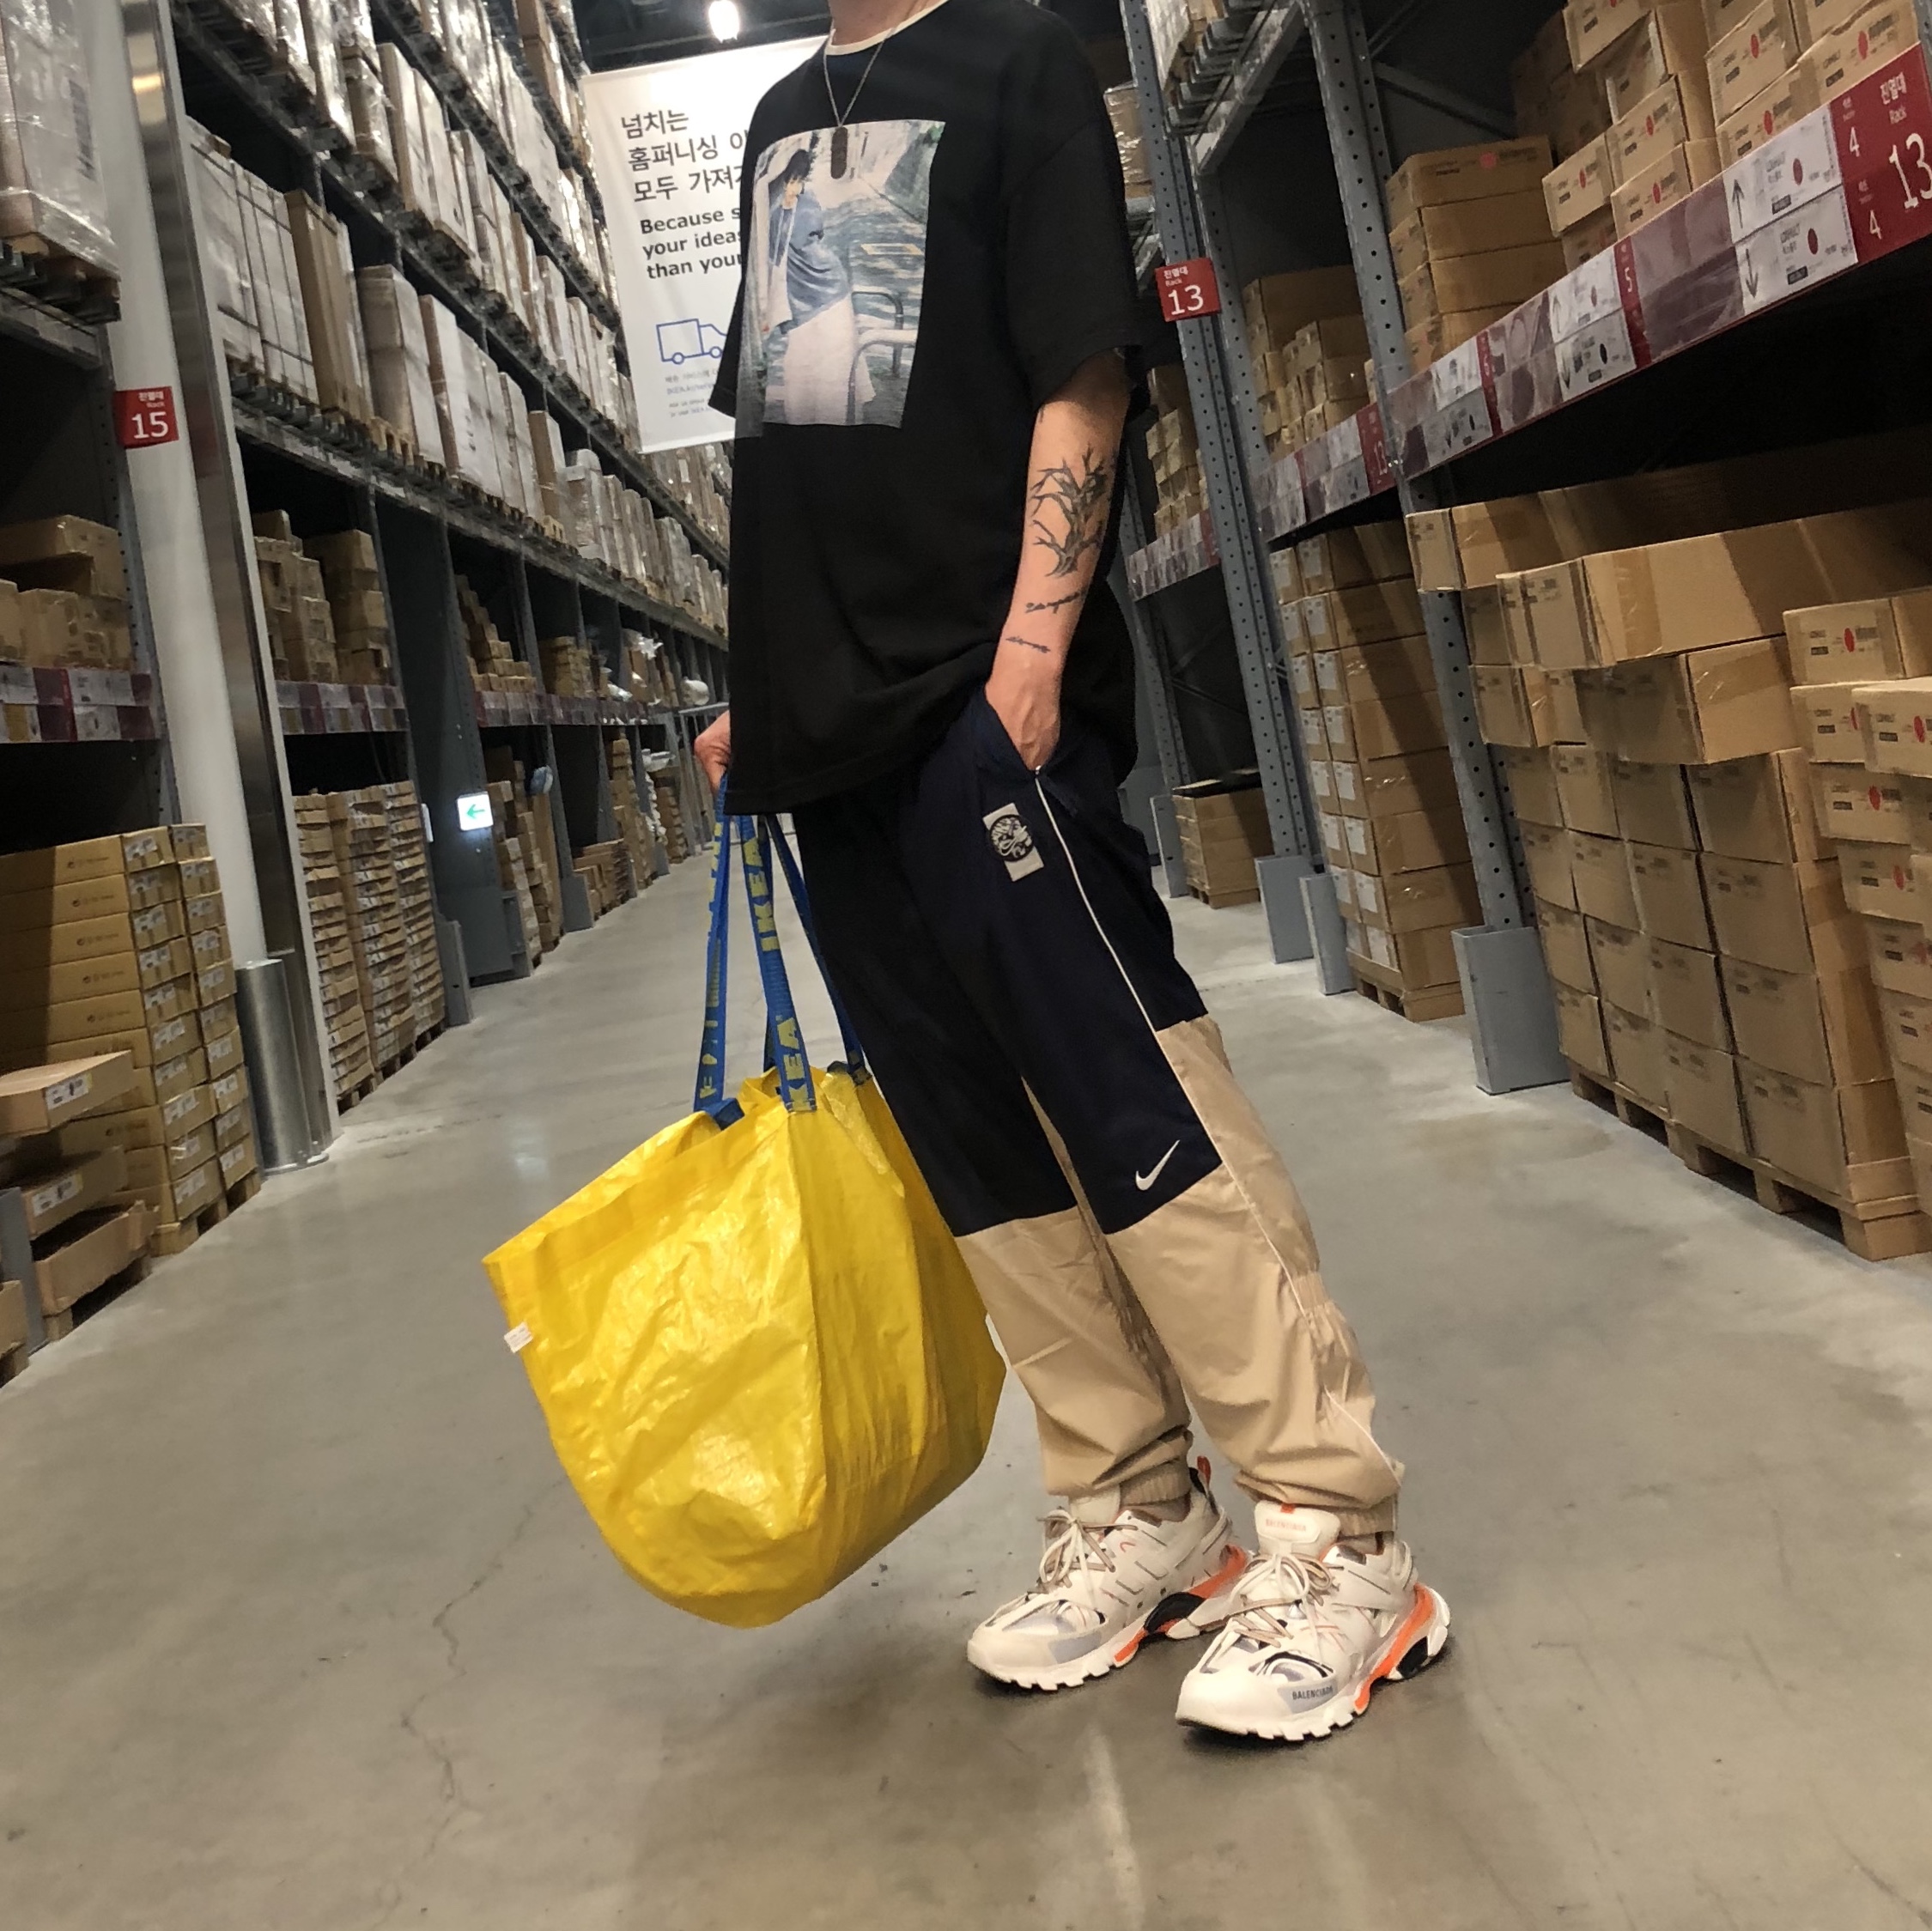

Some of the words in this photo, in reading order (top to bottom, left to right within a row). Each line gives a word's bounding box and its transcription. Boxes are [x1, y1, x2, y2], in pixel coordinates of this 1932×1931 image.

[621, 110, 689, 140] 넘치는
[628, 135, 719, 172] 홈퍼니싱
[1849, 126, 1860, 157] 4
[634, 175, 679, 203] 모두
[688, 165, 742, 194] 가져
[1889, 132, 1932, 209] 13
[640, 209, 725, 234] Because
[731, 207, 740, 220] s
[1868, 209, 1882, 240] 4
[642, 239, 688, 260] your
[647, 260, 693, 279] than
[1168, 284, 1204, 315] 13
[131, 411, 169, 439] 15
[743, 836, 781, 952] IKEA
[776, 1017, 811, 1112] KEA
